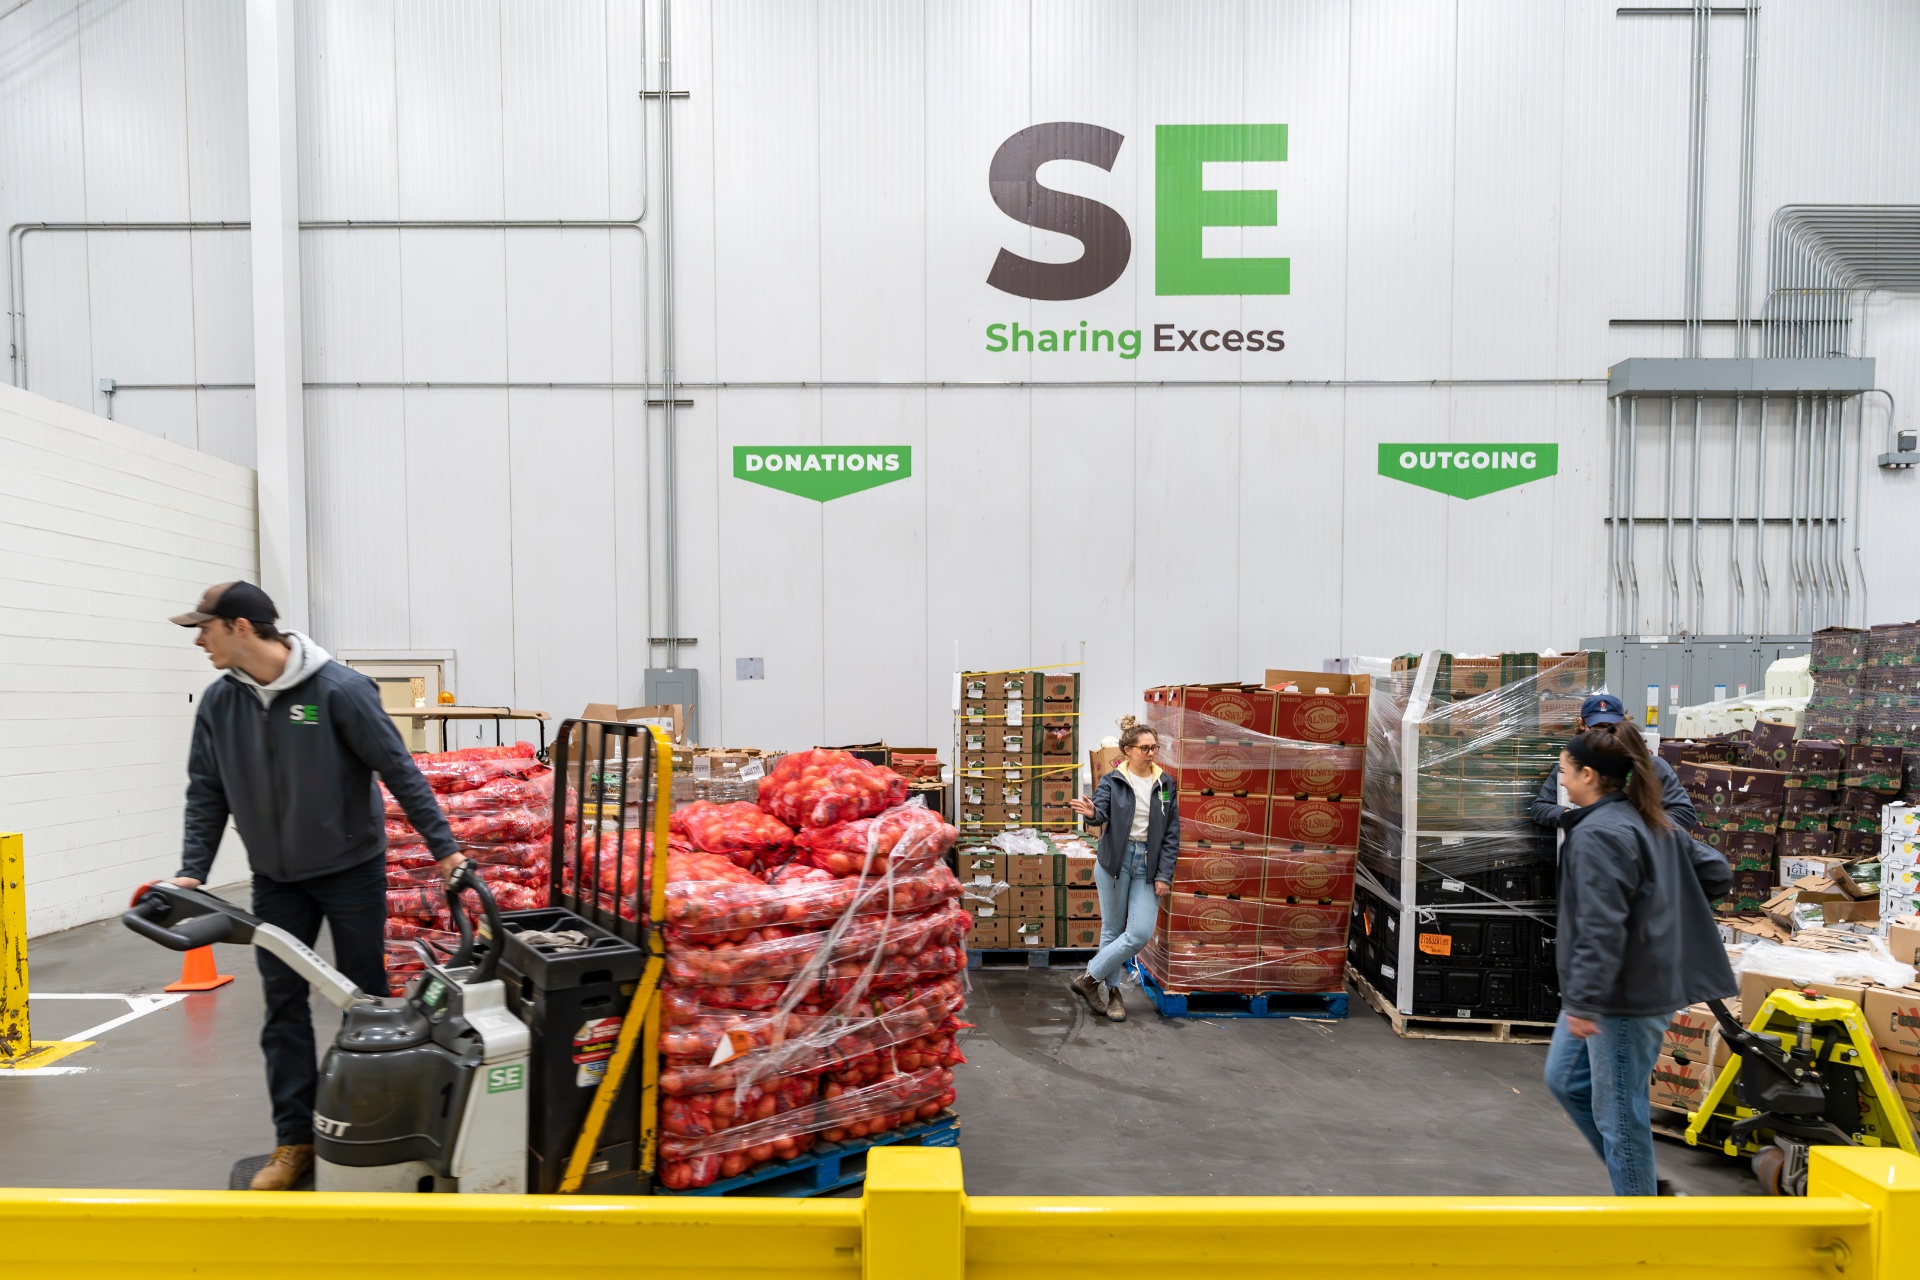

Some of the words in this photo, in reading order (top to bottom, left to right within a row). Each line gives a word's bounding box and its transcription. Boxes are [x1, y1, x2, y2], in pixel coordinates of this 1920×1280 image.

[986, 121, 1290, 301] SE
[985, 320, 1142, 360] Sharing
[1153, 323, 1286, 352] Excess
[746, 454, 900, 472] DONATIONS
[1399, 451, 1537, 469] OUTGOING
[289, 704, 320, 721] SE
[490, 1068, 521, 1087] SE
